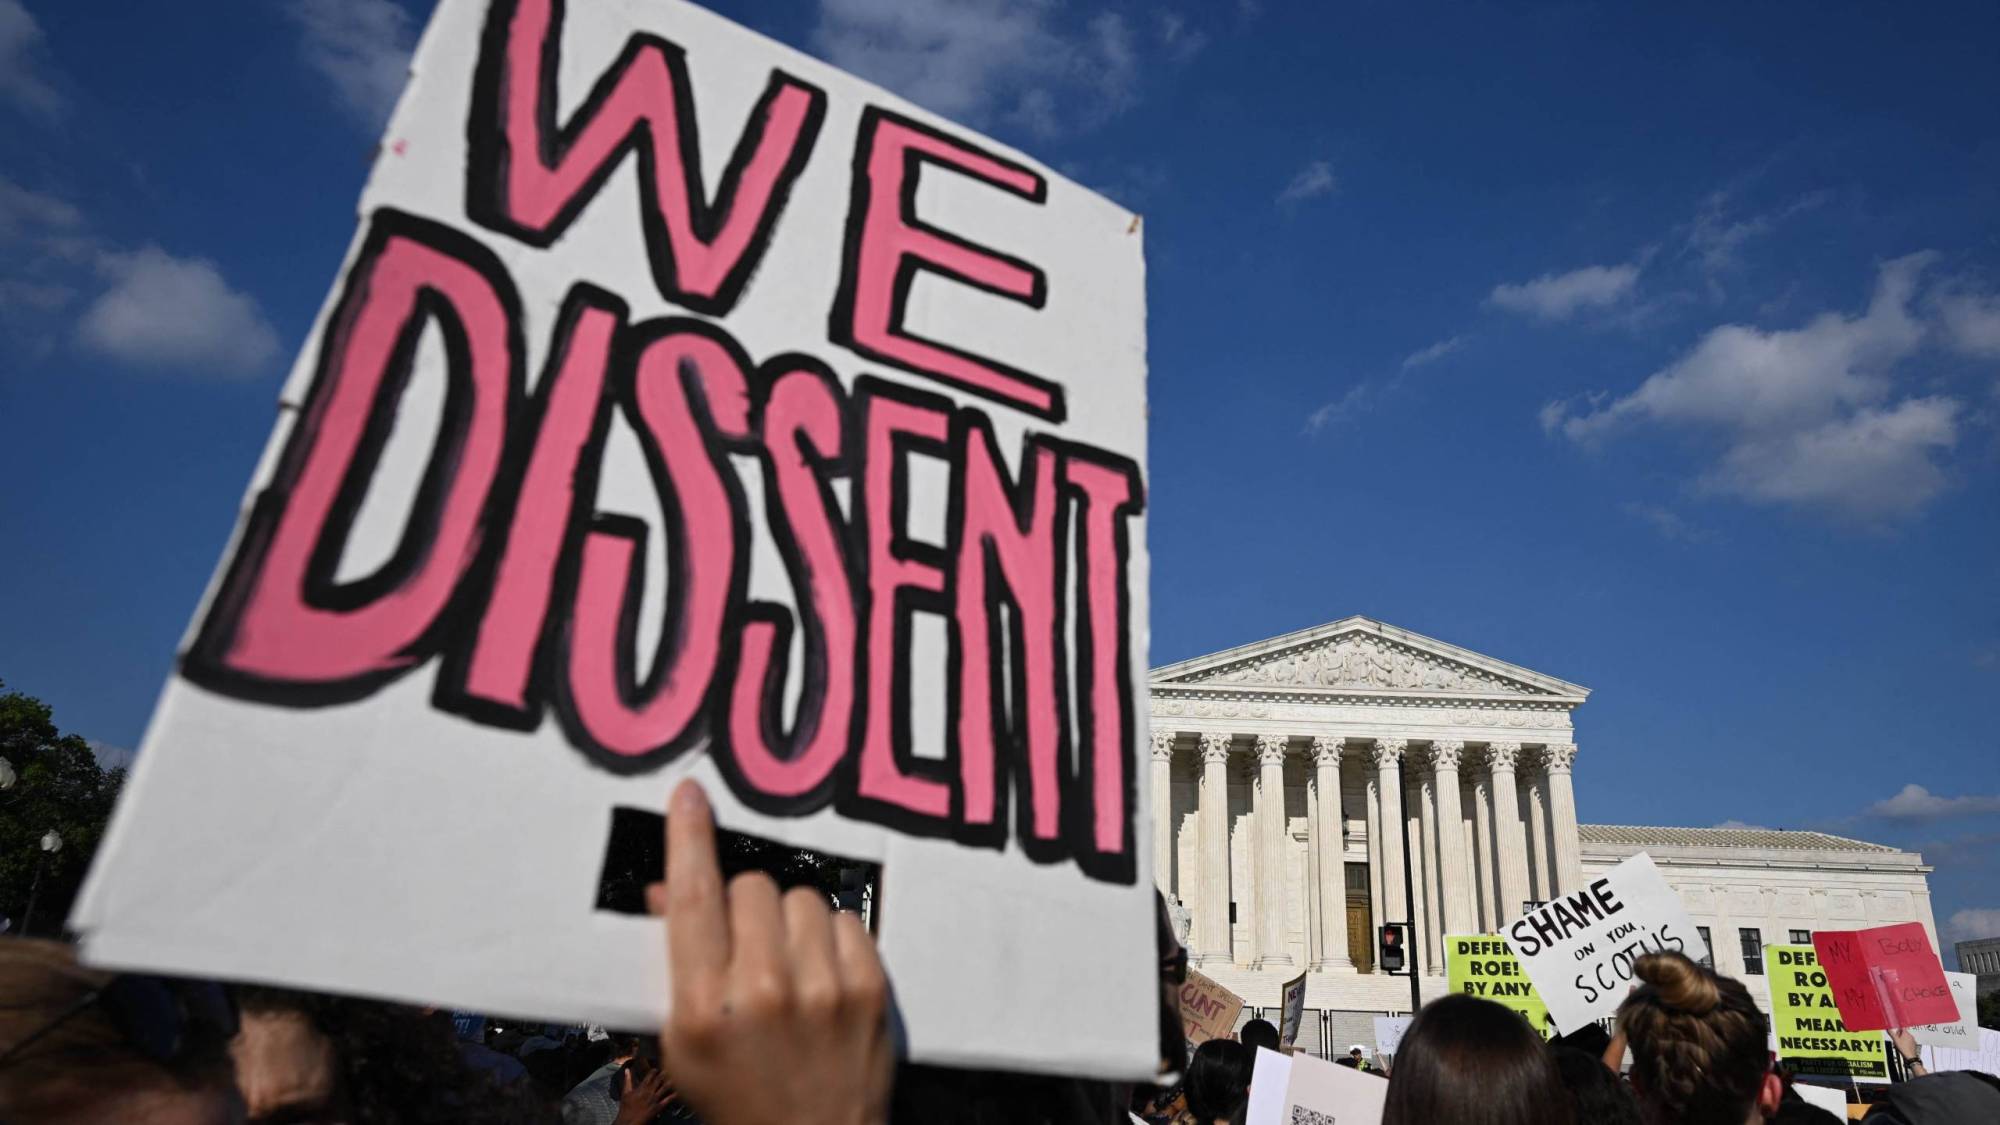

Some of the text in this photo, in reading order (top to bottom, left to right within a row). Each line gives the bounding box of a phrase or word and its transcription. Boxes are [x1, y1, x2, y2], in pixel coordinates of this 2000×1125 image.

[466, 0, 1065, 422] WE
[179, 206, 1143, 885] DISSENT
[1511, 878, 1624, 956] SHAME
[1457, 941, 1514, 956] DEFEN
[1574, 942, 1595, 961] ON
[1470, 961, 1520, 976] ROE!
[1463, 982, 1532, 996] BY ANY
[1903, 984, 1948, 1002] CHOICE
[1180, 983, 1226, 1021] CUNT
[1788, 992, 1814, 1007] BY
[1796, 1018, 1847, 1032] MEAN
[1780, 1037, 1882, 1053] NECESSARY!
